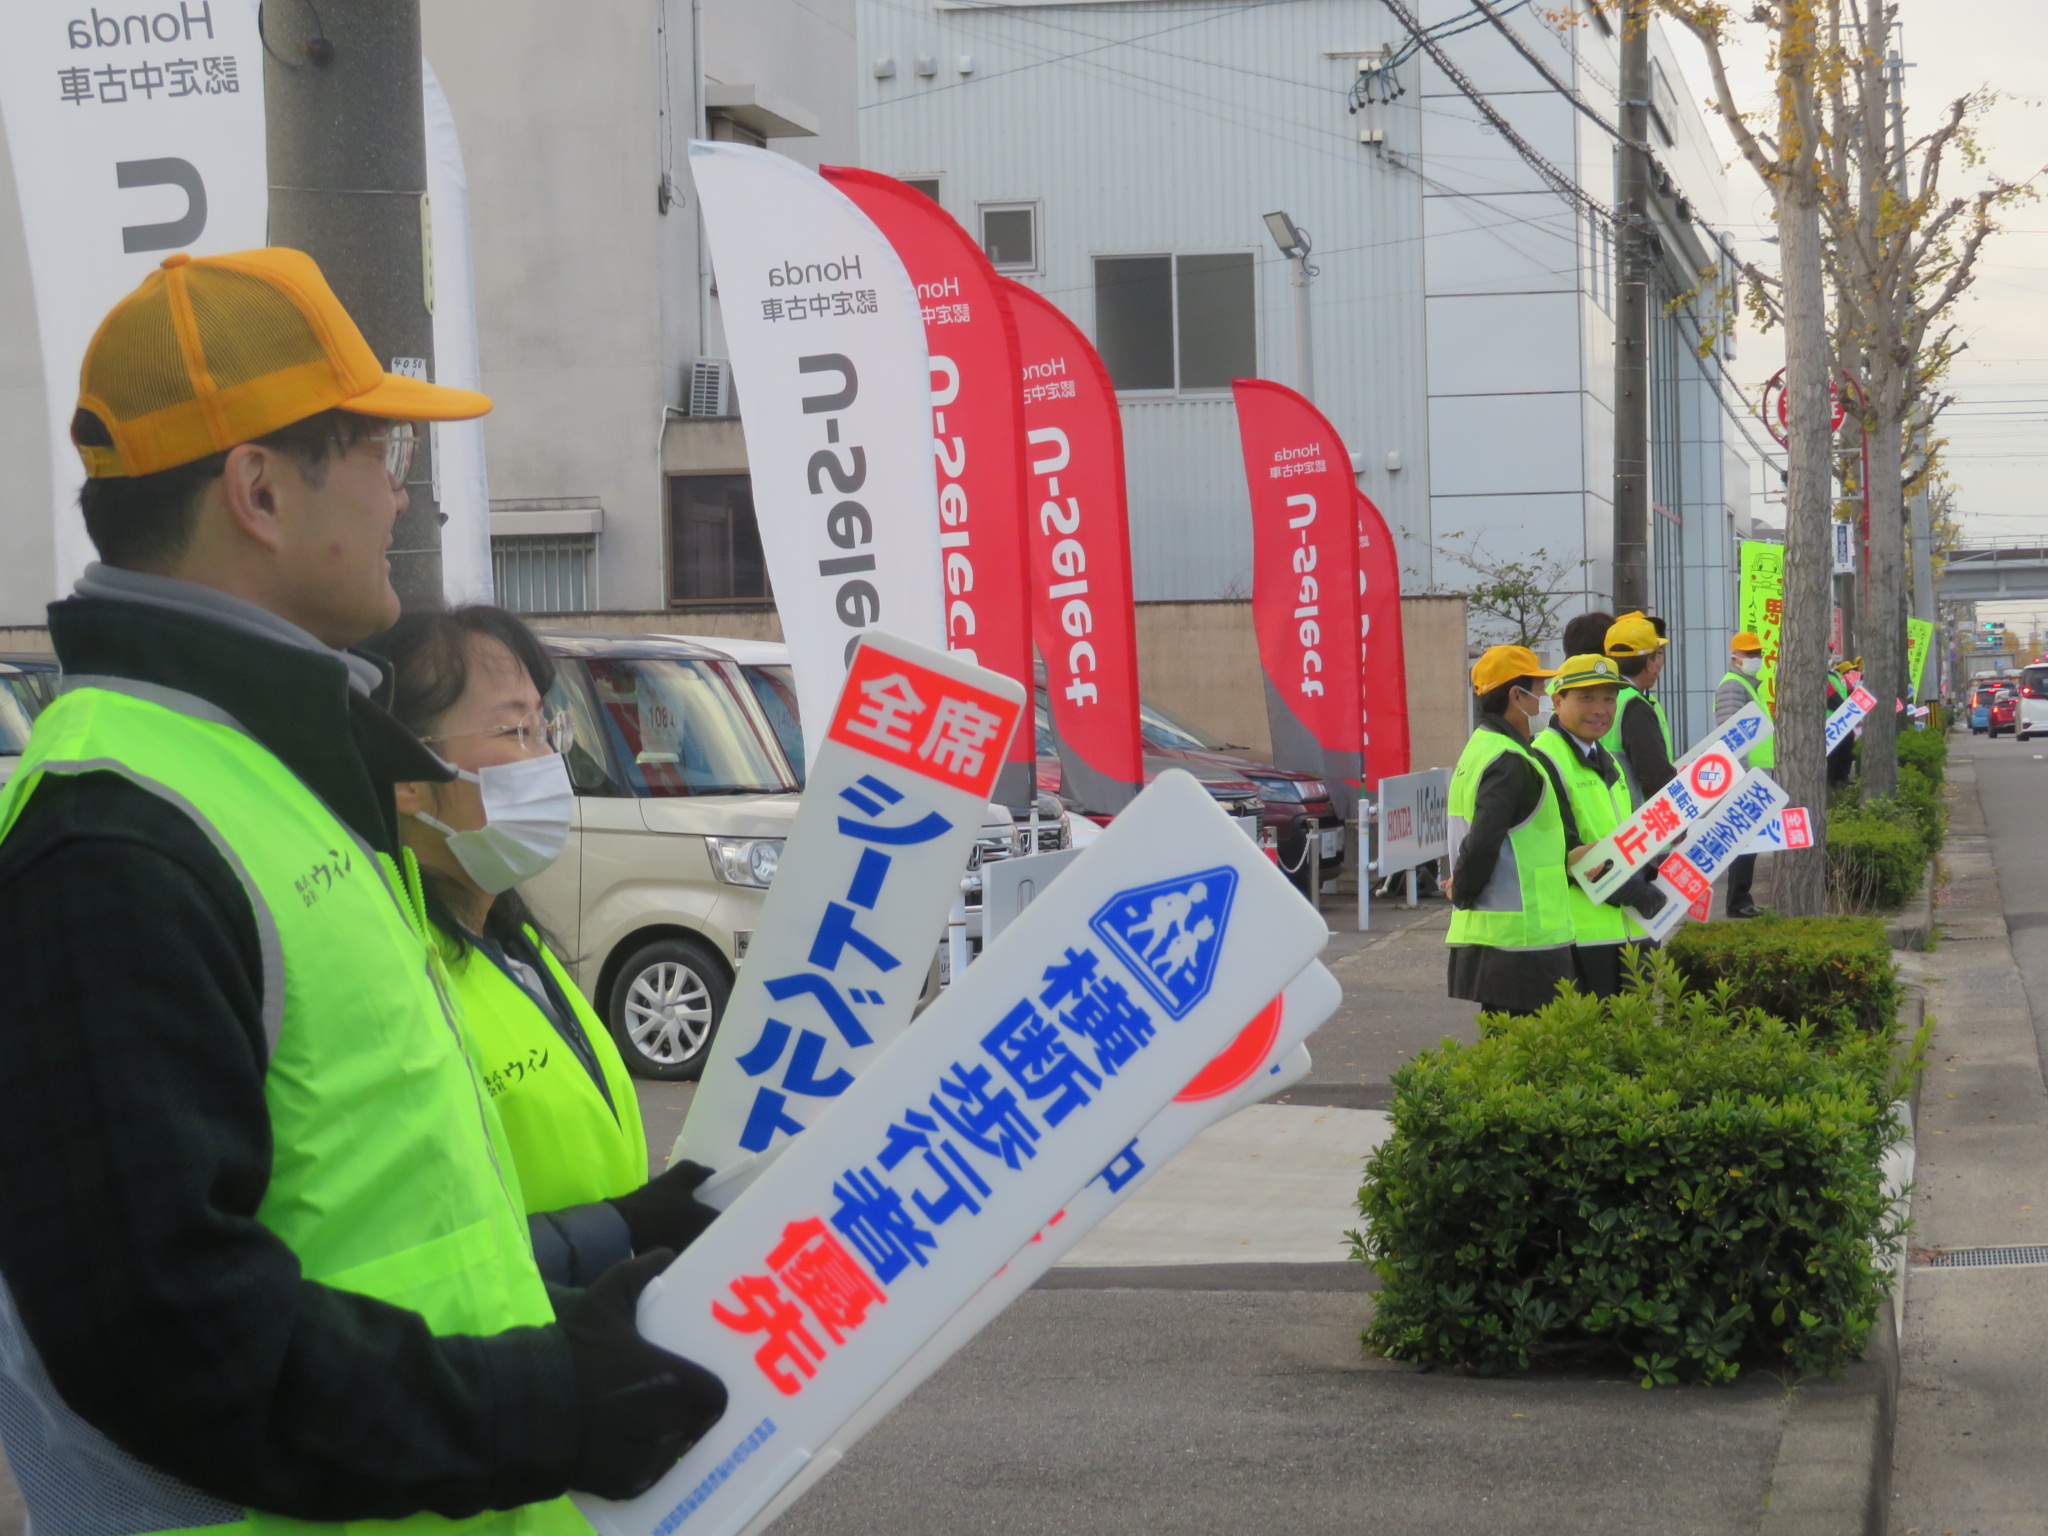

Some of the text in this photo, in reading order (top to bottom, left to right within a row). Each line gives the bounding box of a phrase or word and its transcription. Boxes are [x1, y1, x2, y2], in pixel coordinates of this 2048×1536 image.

[846, 672, 1003, 779] 全席
[1387, 805, 1413, 843] HONDA
[1613, 796, 1682, 867] 禁止
[1667, 779, 1700, 821] 運転中
[1685, 780, 1777, 874] 交通安全運動
[1662, 857, 1703, 895] 実施中
[736, 774, 954, 1154] シートベルト
